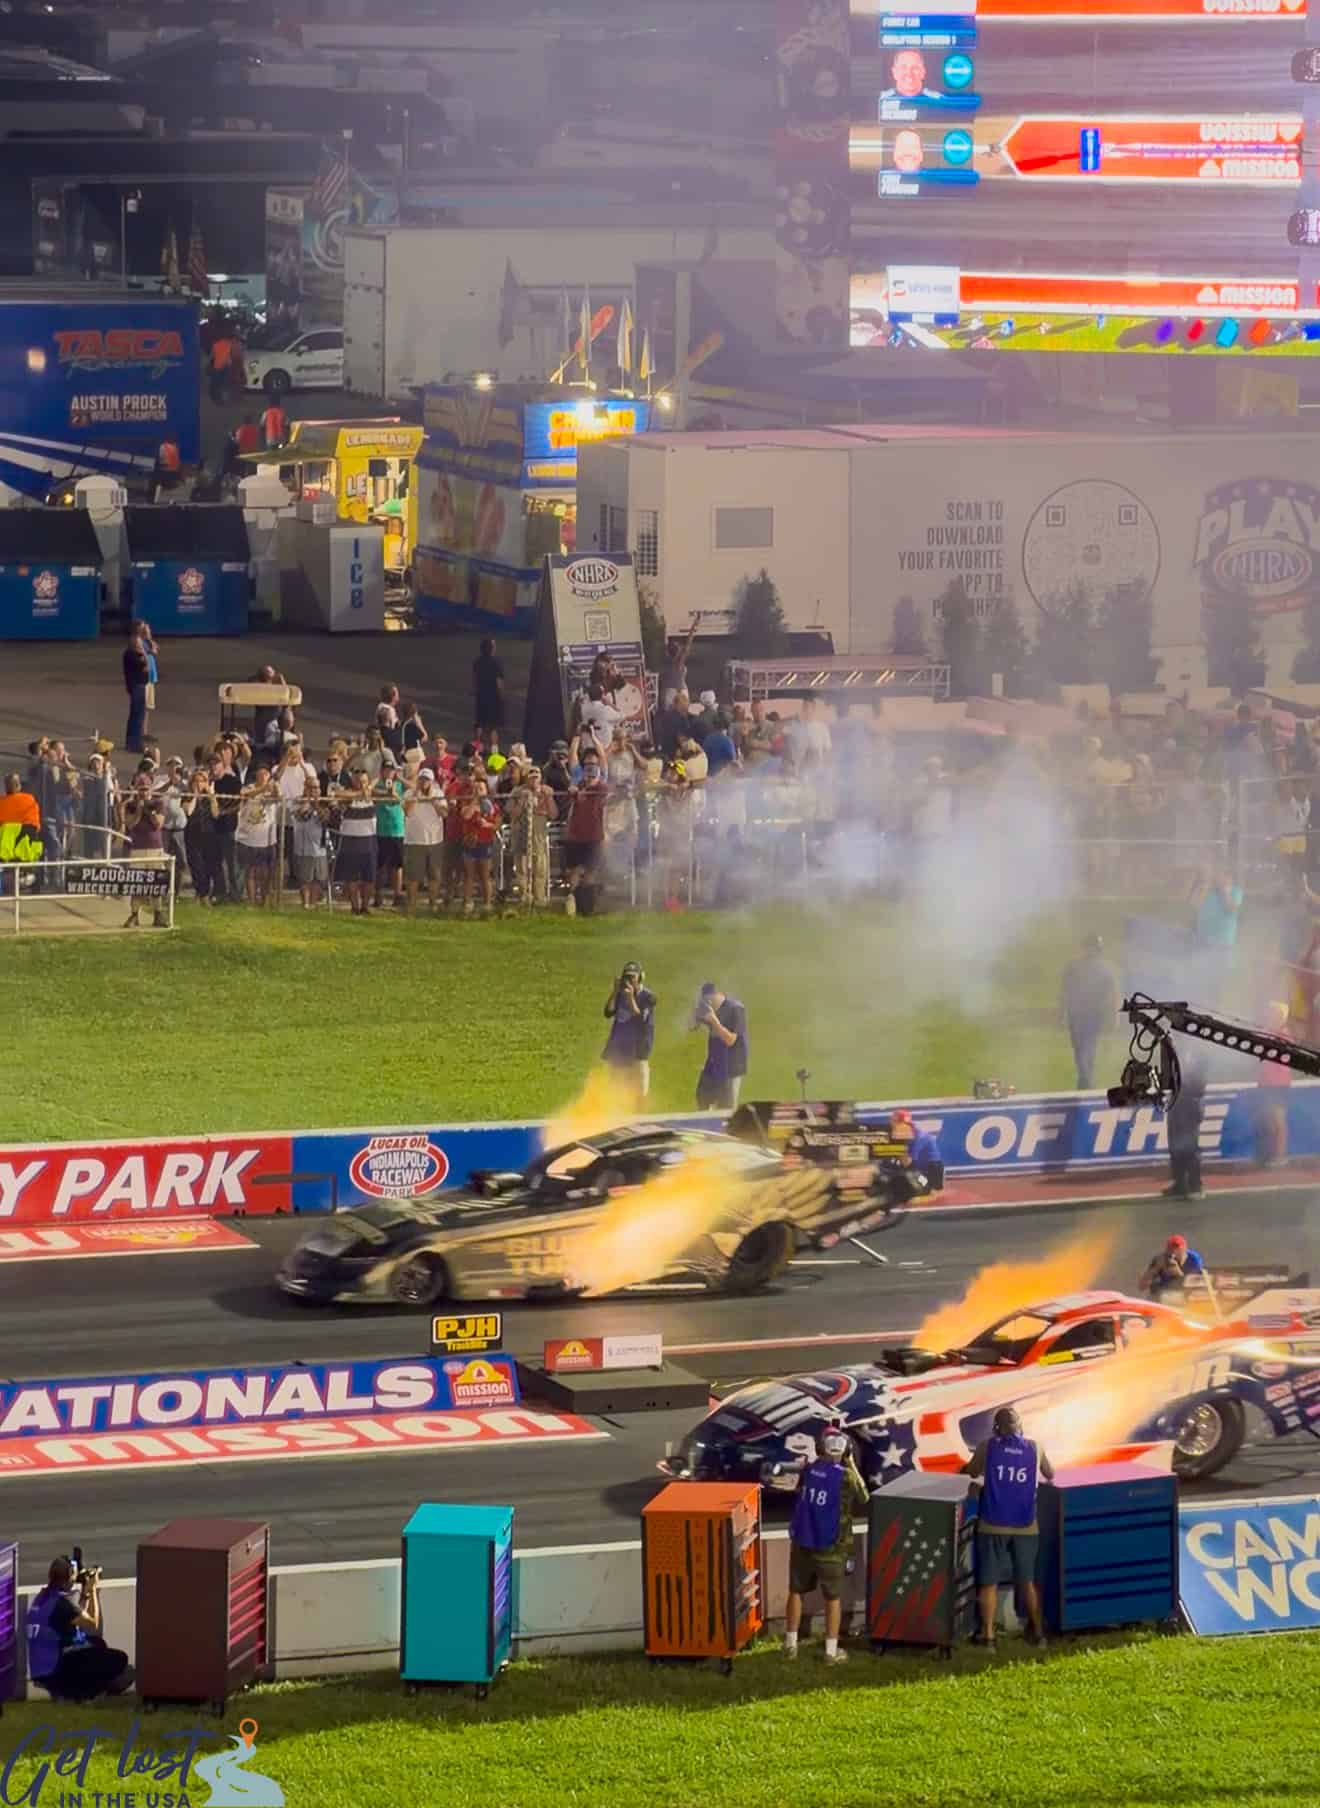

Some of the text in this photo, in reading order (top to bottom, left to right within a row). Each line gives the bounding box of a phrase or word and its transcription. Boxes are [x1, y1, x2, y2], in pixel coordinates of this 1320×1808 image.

[1220, 287, 1296, 304] mission
[54, 330, 183, 358] TASCA
[72, 394, 167, 411] AUSTIN PROCK
[946, 501, 1004, 521] SCAN TO
[927, 526, 1004, 546] DOWNLOAD
[898, 550, 1004, 570] YOUR FAVORITE
[1231, 551, 1296, 584] NHRA
[573, 564, 613, 585] NHRA
[988, 574, 1004, 593] TO
[67, 882, 168, 897] WRECKER SERVICE
[965, 1104, 1229, 1160] OF THE
[370, 1137, 428, 1150] LUCAS OIL
[369, 1151, 429, 1170] INDIANAPOLIS
[52, 1150, 260, 1215] PARK
[372, 1168, 426, 1185] RACEWAY
[384, 1187, 413, 1198] PARK
[437, 1316, 497, 1339] PJH
[457, 1382, 508, 1396] mission
[35, 1409, 575, 1463] mission
[996, 1464, 1028, 1483] 116
